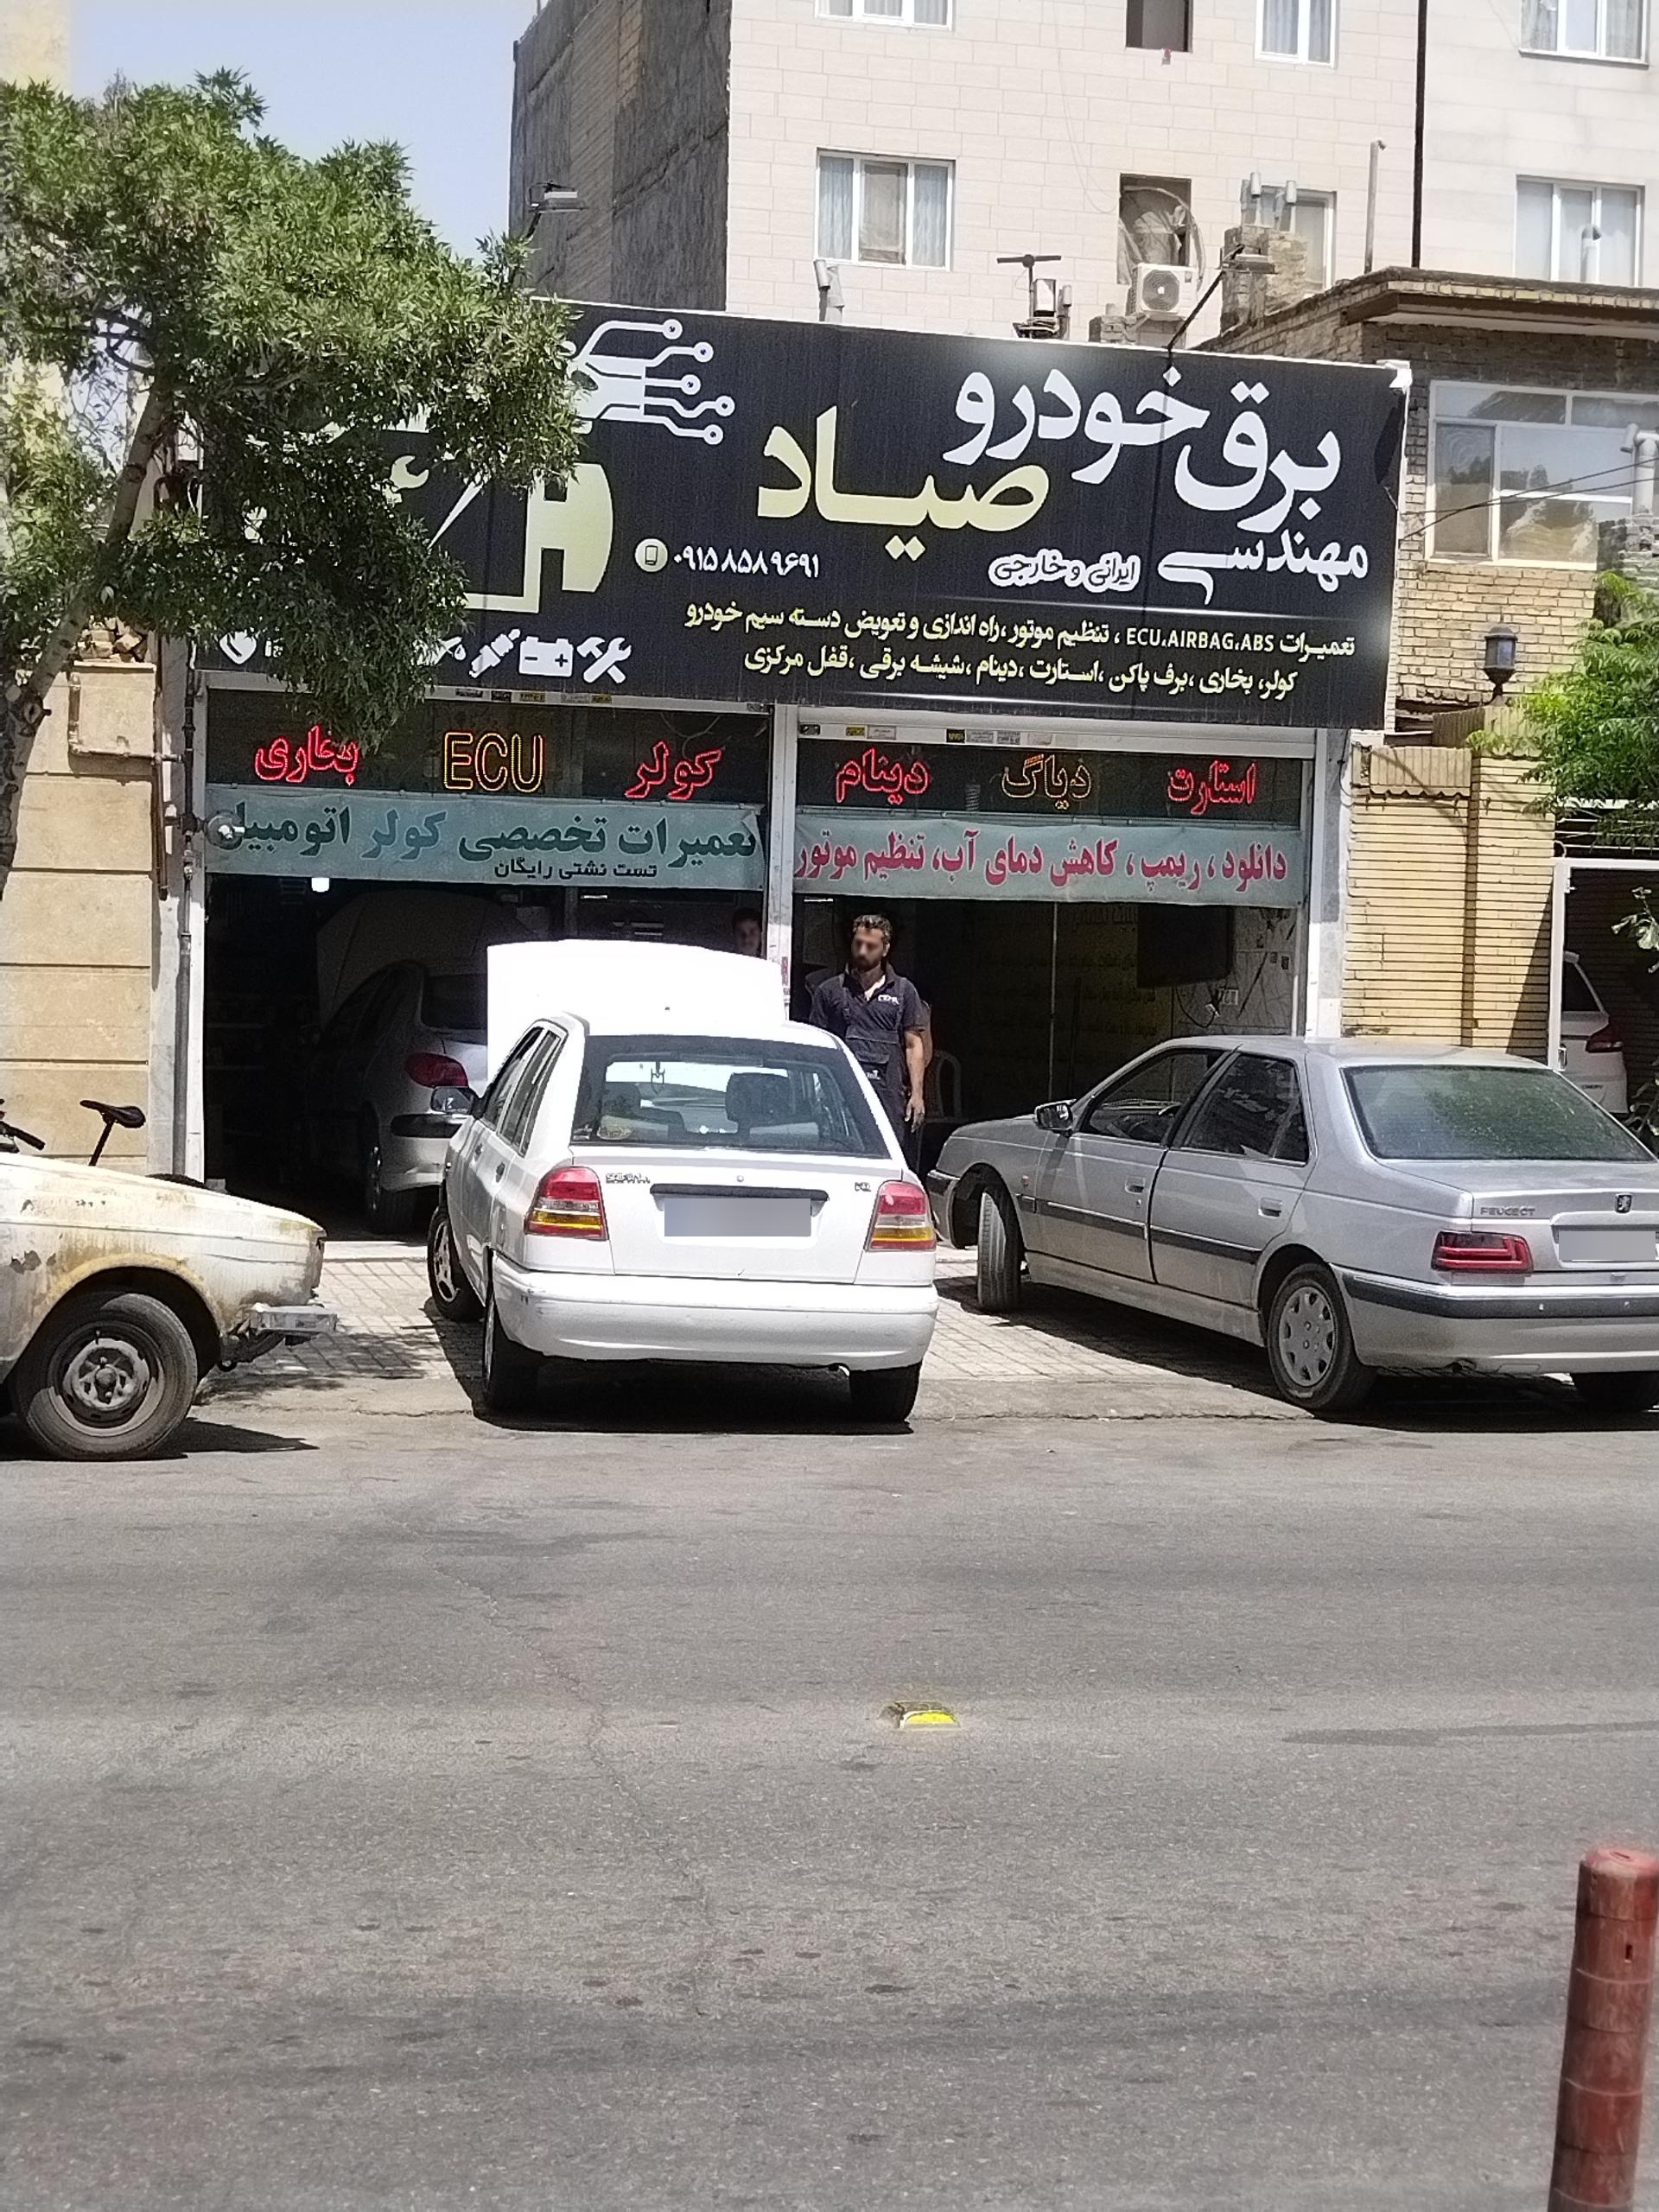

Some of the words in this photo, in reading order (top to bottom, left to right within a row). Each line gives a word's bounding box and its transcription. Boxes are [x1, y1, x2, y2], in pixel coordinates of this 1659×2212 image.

[944, 366, 1210, 484] خودرو
[1175, 381, 1340, 533] برق
[757, 405, 1049, 562] صیاد
[991, 551, 1067, 586] خارجی
[1067, 563, 1083, 584] و
[1086, 553, 1140, 591] ایرانی
[1158, 529, 1368, 605] مهندسی
[684, 601, 742, 632] خودرو
[745, 610, 785, 633] سیم
[788, 607, 841, 629] دسته
[843, 609, 906, 639] تعویض
[906, 617, 919, 639] و
[923, 611, 976, 639] اندازی
[1007, 620, 1054, 649] موتور
[1057, 620, 1109, 650] تنظیم
[1280, 632, 1355, 662] تعمیرات
[744, 645, 804, 675] مرکزی
[859, 649, 906, 680] برقی
[1108, 663, 1151, 693] پاکن
[1198, 665, 1254, 695] بخاری
[443, 731, 544, 793] ECU
[624, 739, 722, 800] کولر
[836, 746, 931, 805] دینام
[1001, 753, 1091, 810] دیاگ
[1167, 760, 1257, 816] استارت
[221, 800, 352, 857] اتومبیل
[360, 809, 448, 861] کولر
[458, 814, 607, 861] تخصصی
[494, 857, 553, 880] رایگان
[558, 859, 607, 880] نشتی
[613, 861, 658, 878] تست
[793, 830, 858, 880] موتور
[863, 830, 926, 883] تنظیم
[985, 835, 1043, 887] دمای
[1049, 837, 1119, 887] کاهش
[1140, 851, 1201, 893] ریمپ
[1222, 842, 1287, 893] دانلود
[1480, 1206, 1535, 1217] PEUGEOT
